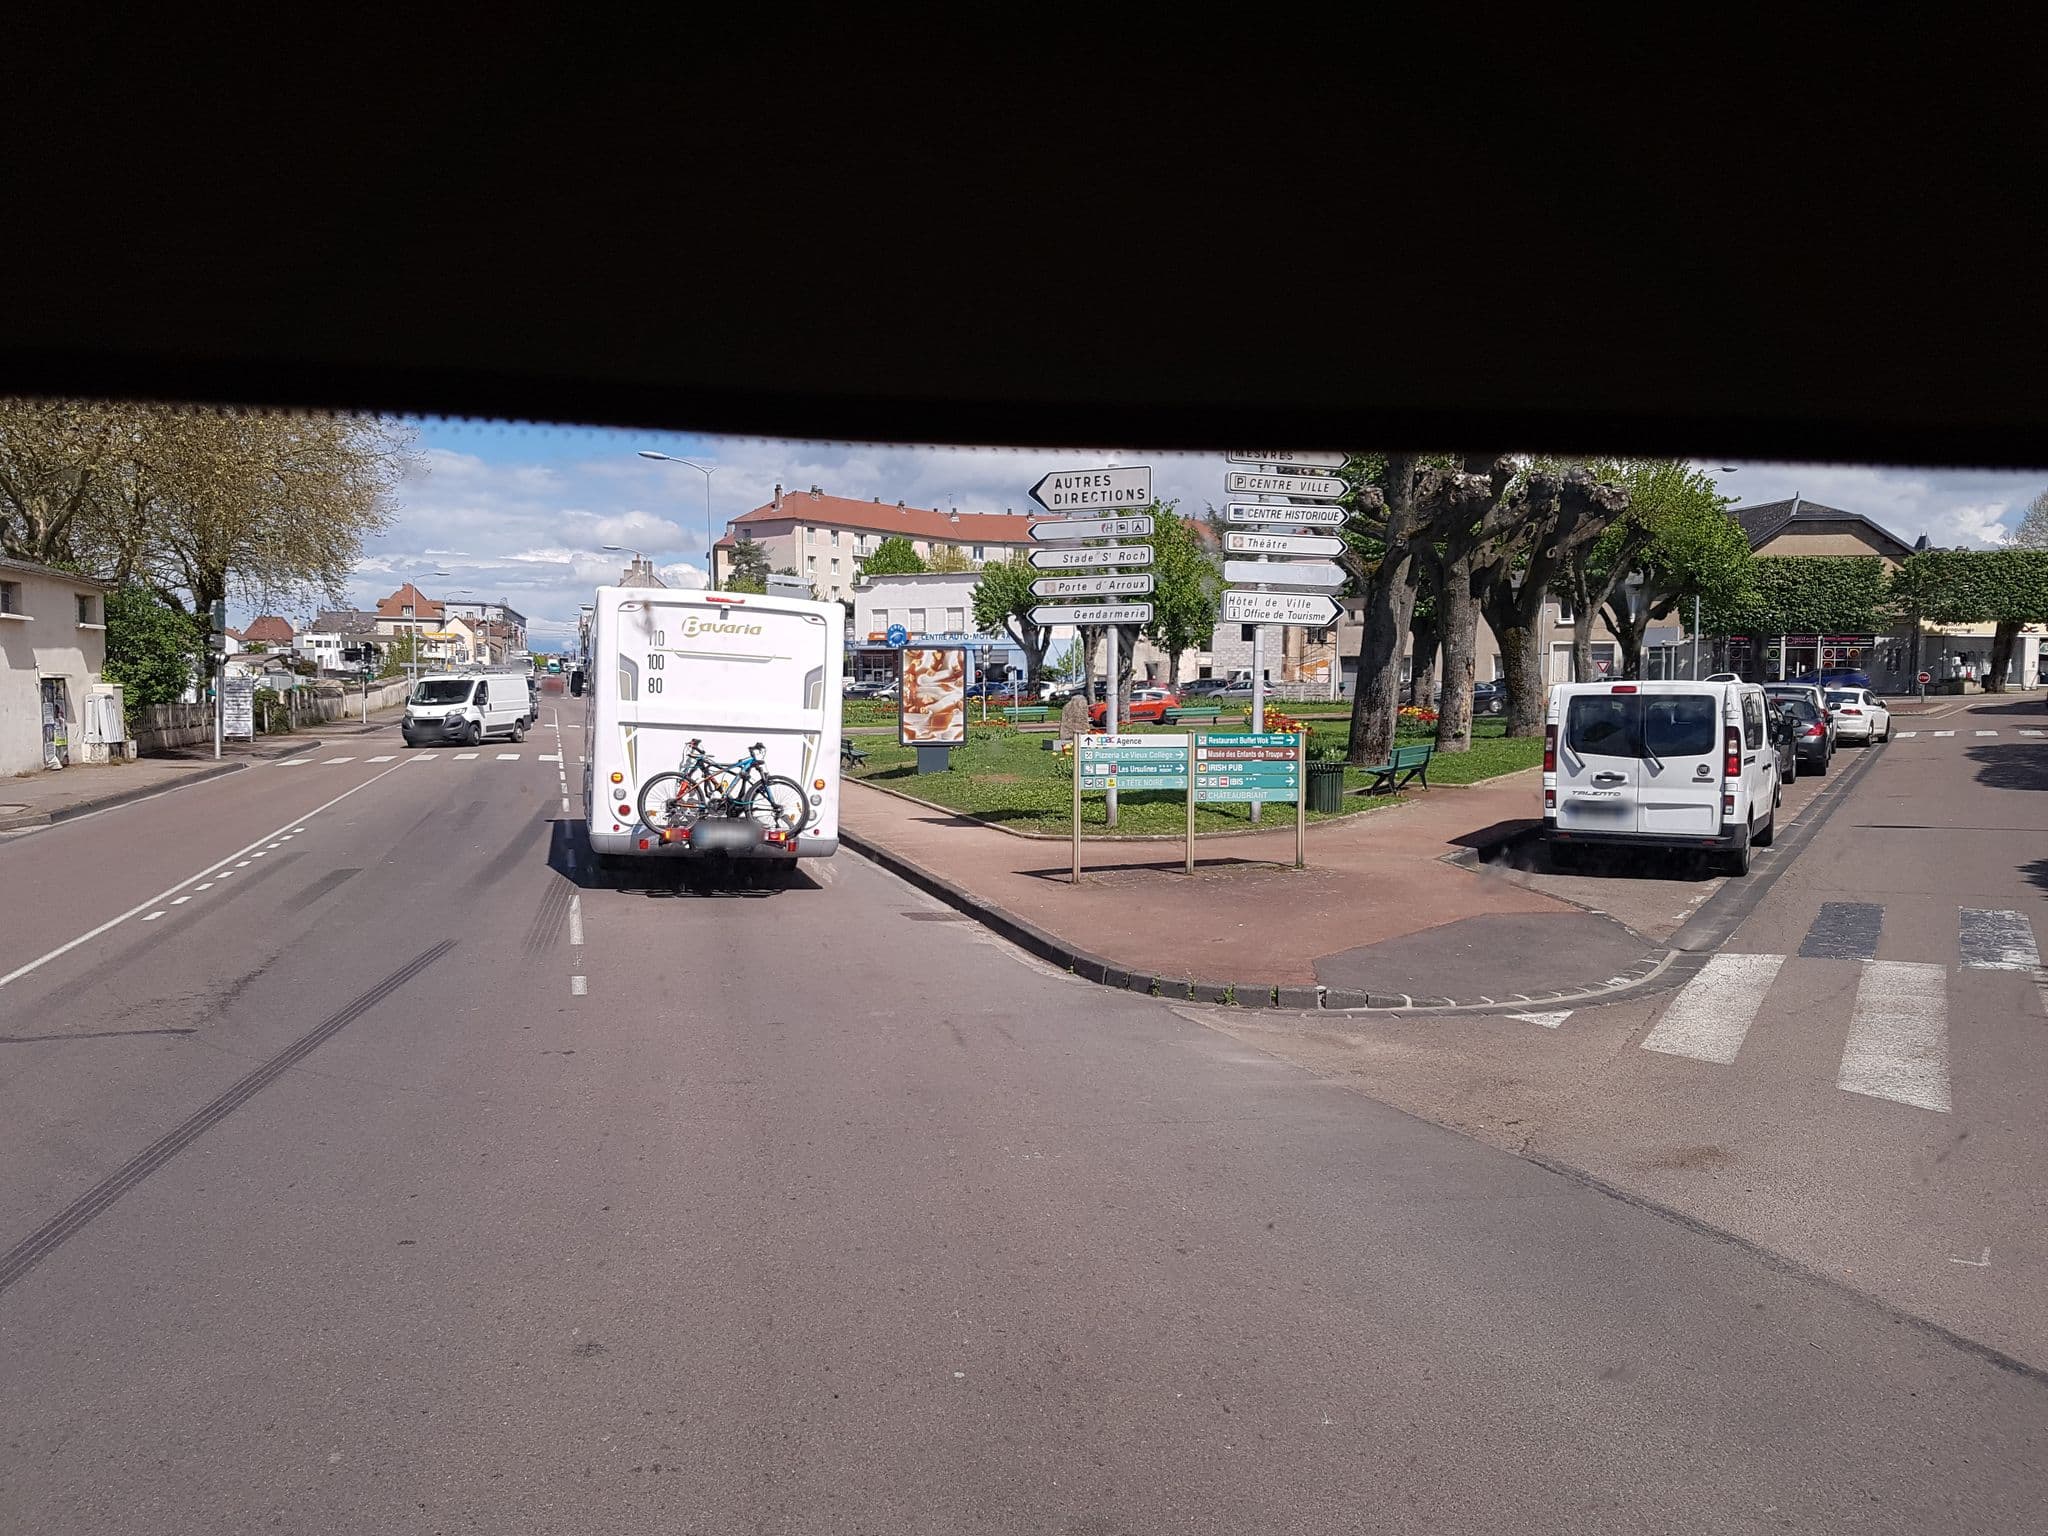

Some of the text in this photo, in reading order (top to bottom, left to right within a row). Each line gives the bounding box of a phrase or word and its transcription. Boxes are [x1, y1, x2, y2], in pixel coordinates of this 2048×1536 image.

[1055, 475, 1111, 489] AUTRES
[1249, 479, 1292, 490] CENTRE
[1300, 482, 1330, 492] VILLE
[1054, 488, 1145, 505] DIRECTIONS
[1247, 508, 1339, 521] CENTRE HISTORIQUE
[1248, 538, 1288, 549] Théâtre
[1062, 554, 1094, 563] Stade
[1119, 551, 1146, 561] Roch
[1059, 582, 1087, 592] Porte
[1228, 596, 1312, 609] Hôtel de Ville
[1074, 609, 1146, 619] Gendarmerie
[1244, 608, 1271, 619] Office
[1273, 610, 1284, 619] de
[1288, 611, 1326, 621] Tourisme
[682, 616, 762, 637] Bavaria
[647, 654, 665, 670] 100
[648, 677, 663, 693] 80
[1116, 738, 1142, 746] Agence
[1208, 736, 1239, 744] Restaurant
[1239, 736, 1257, 744] Buffet
[1257, 736, 1269, 744] Wok
[1207, 750, 1283, 759] Musée des Enfants de Troupe
[1118, 765, 1129, 773] Les
[1130, 765, 1158, 773] Ursulines
[1208, 763, 1243, 772] IRISH PUB
